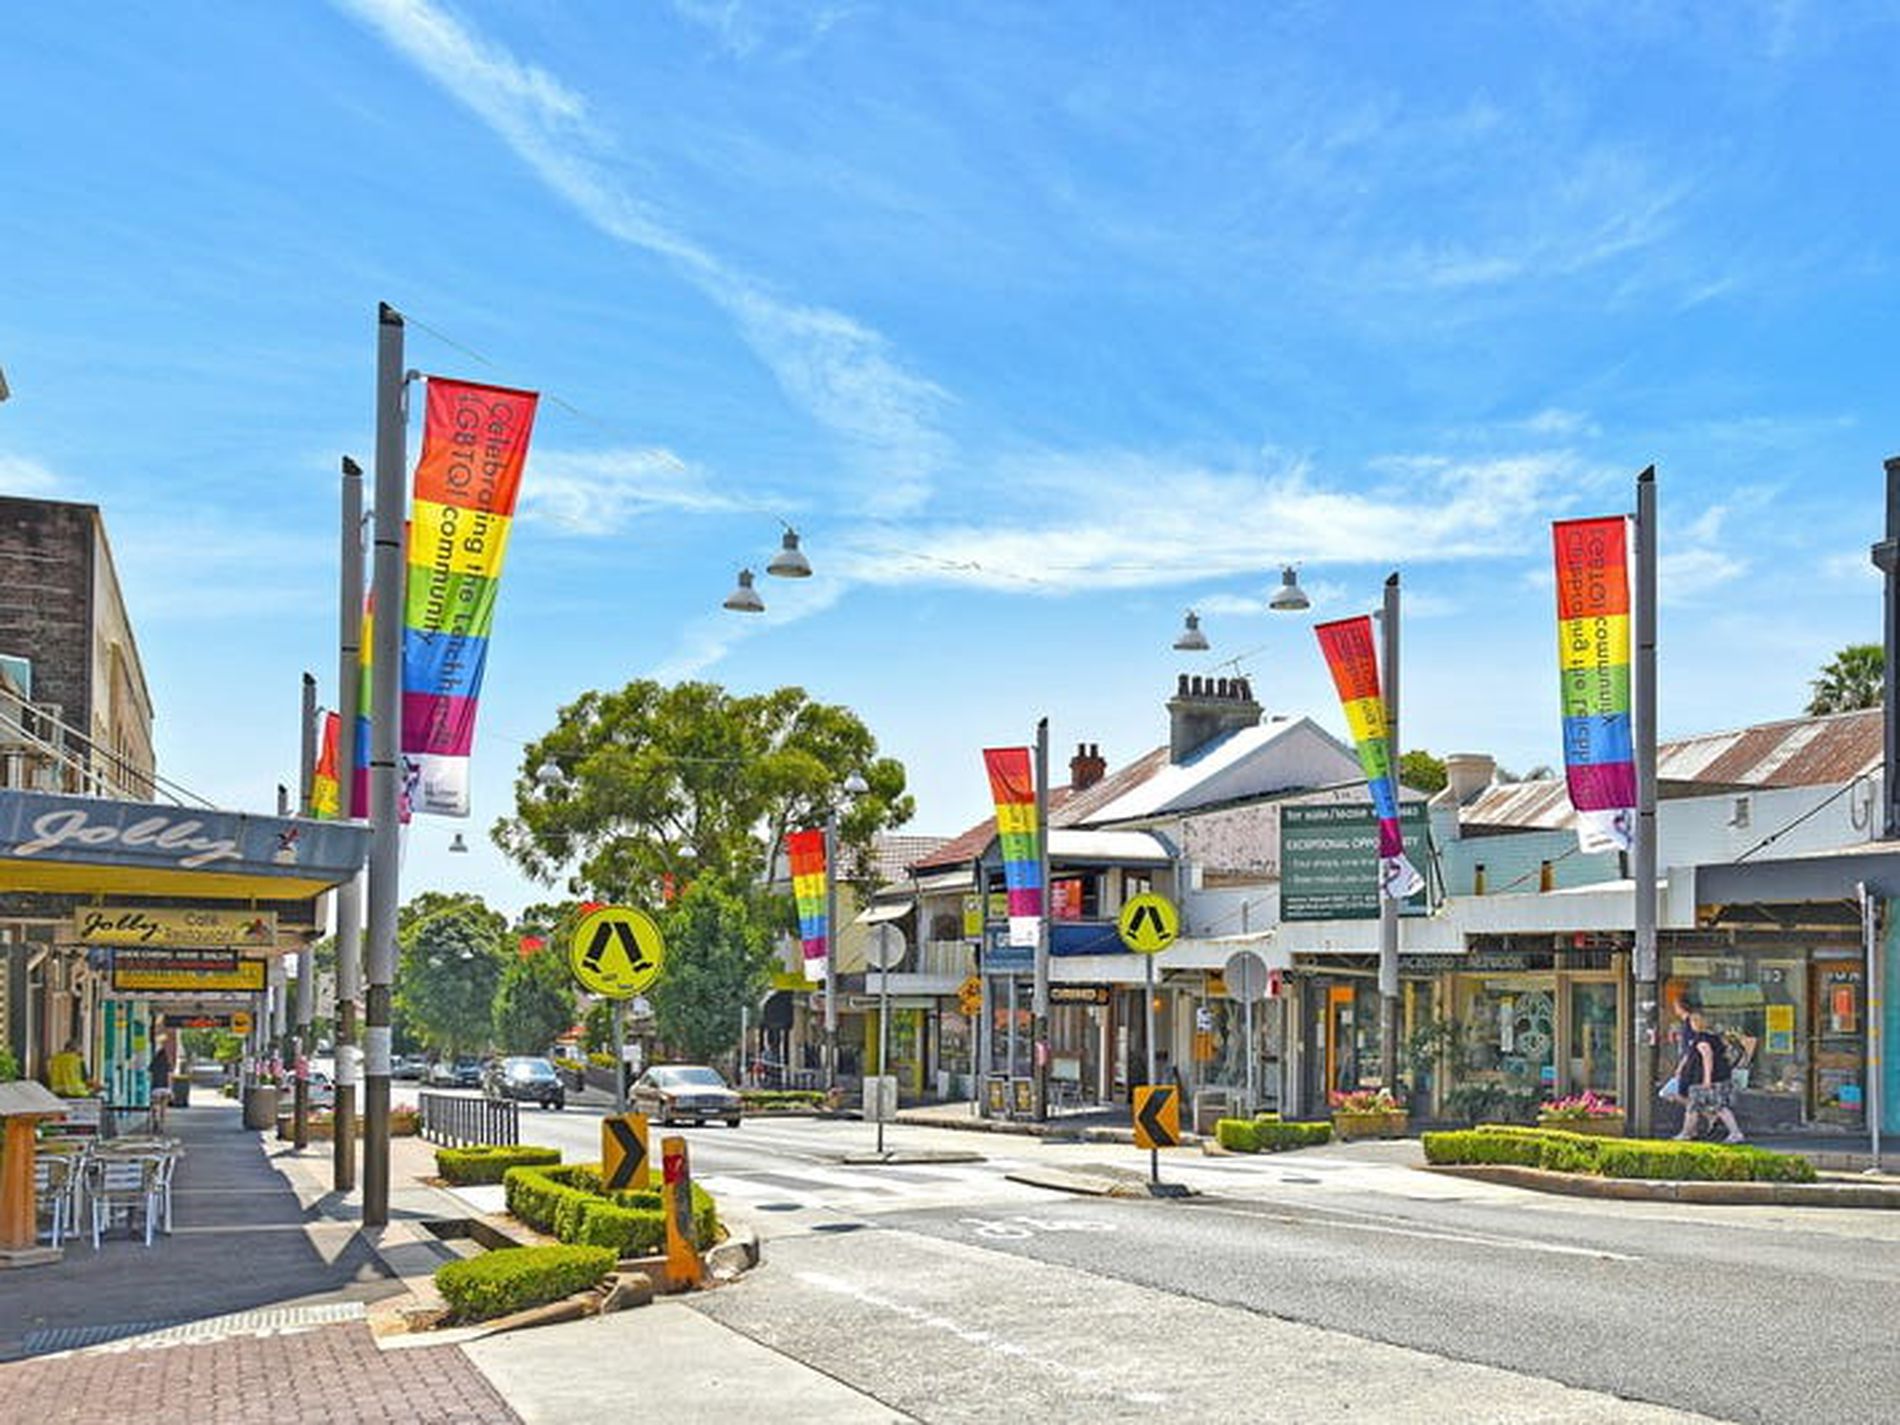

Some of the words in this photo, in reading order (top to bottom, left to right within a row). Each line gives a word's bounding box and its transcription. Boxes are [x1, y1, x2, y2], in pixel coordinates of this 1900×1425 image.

[464, 401, 513, 555] Celebrating
[417, 507, 458, 646] community
[459, 563, 485, 603] the
[13, 809, 243, 868] Jolly
[82, 911, 160, 942] Jolly
